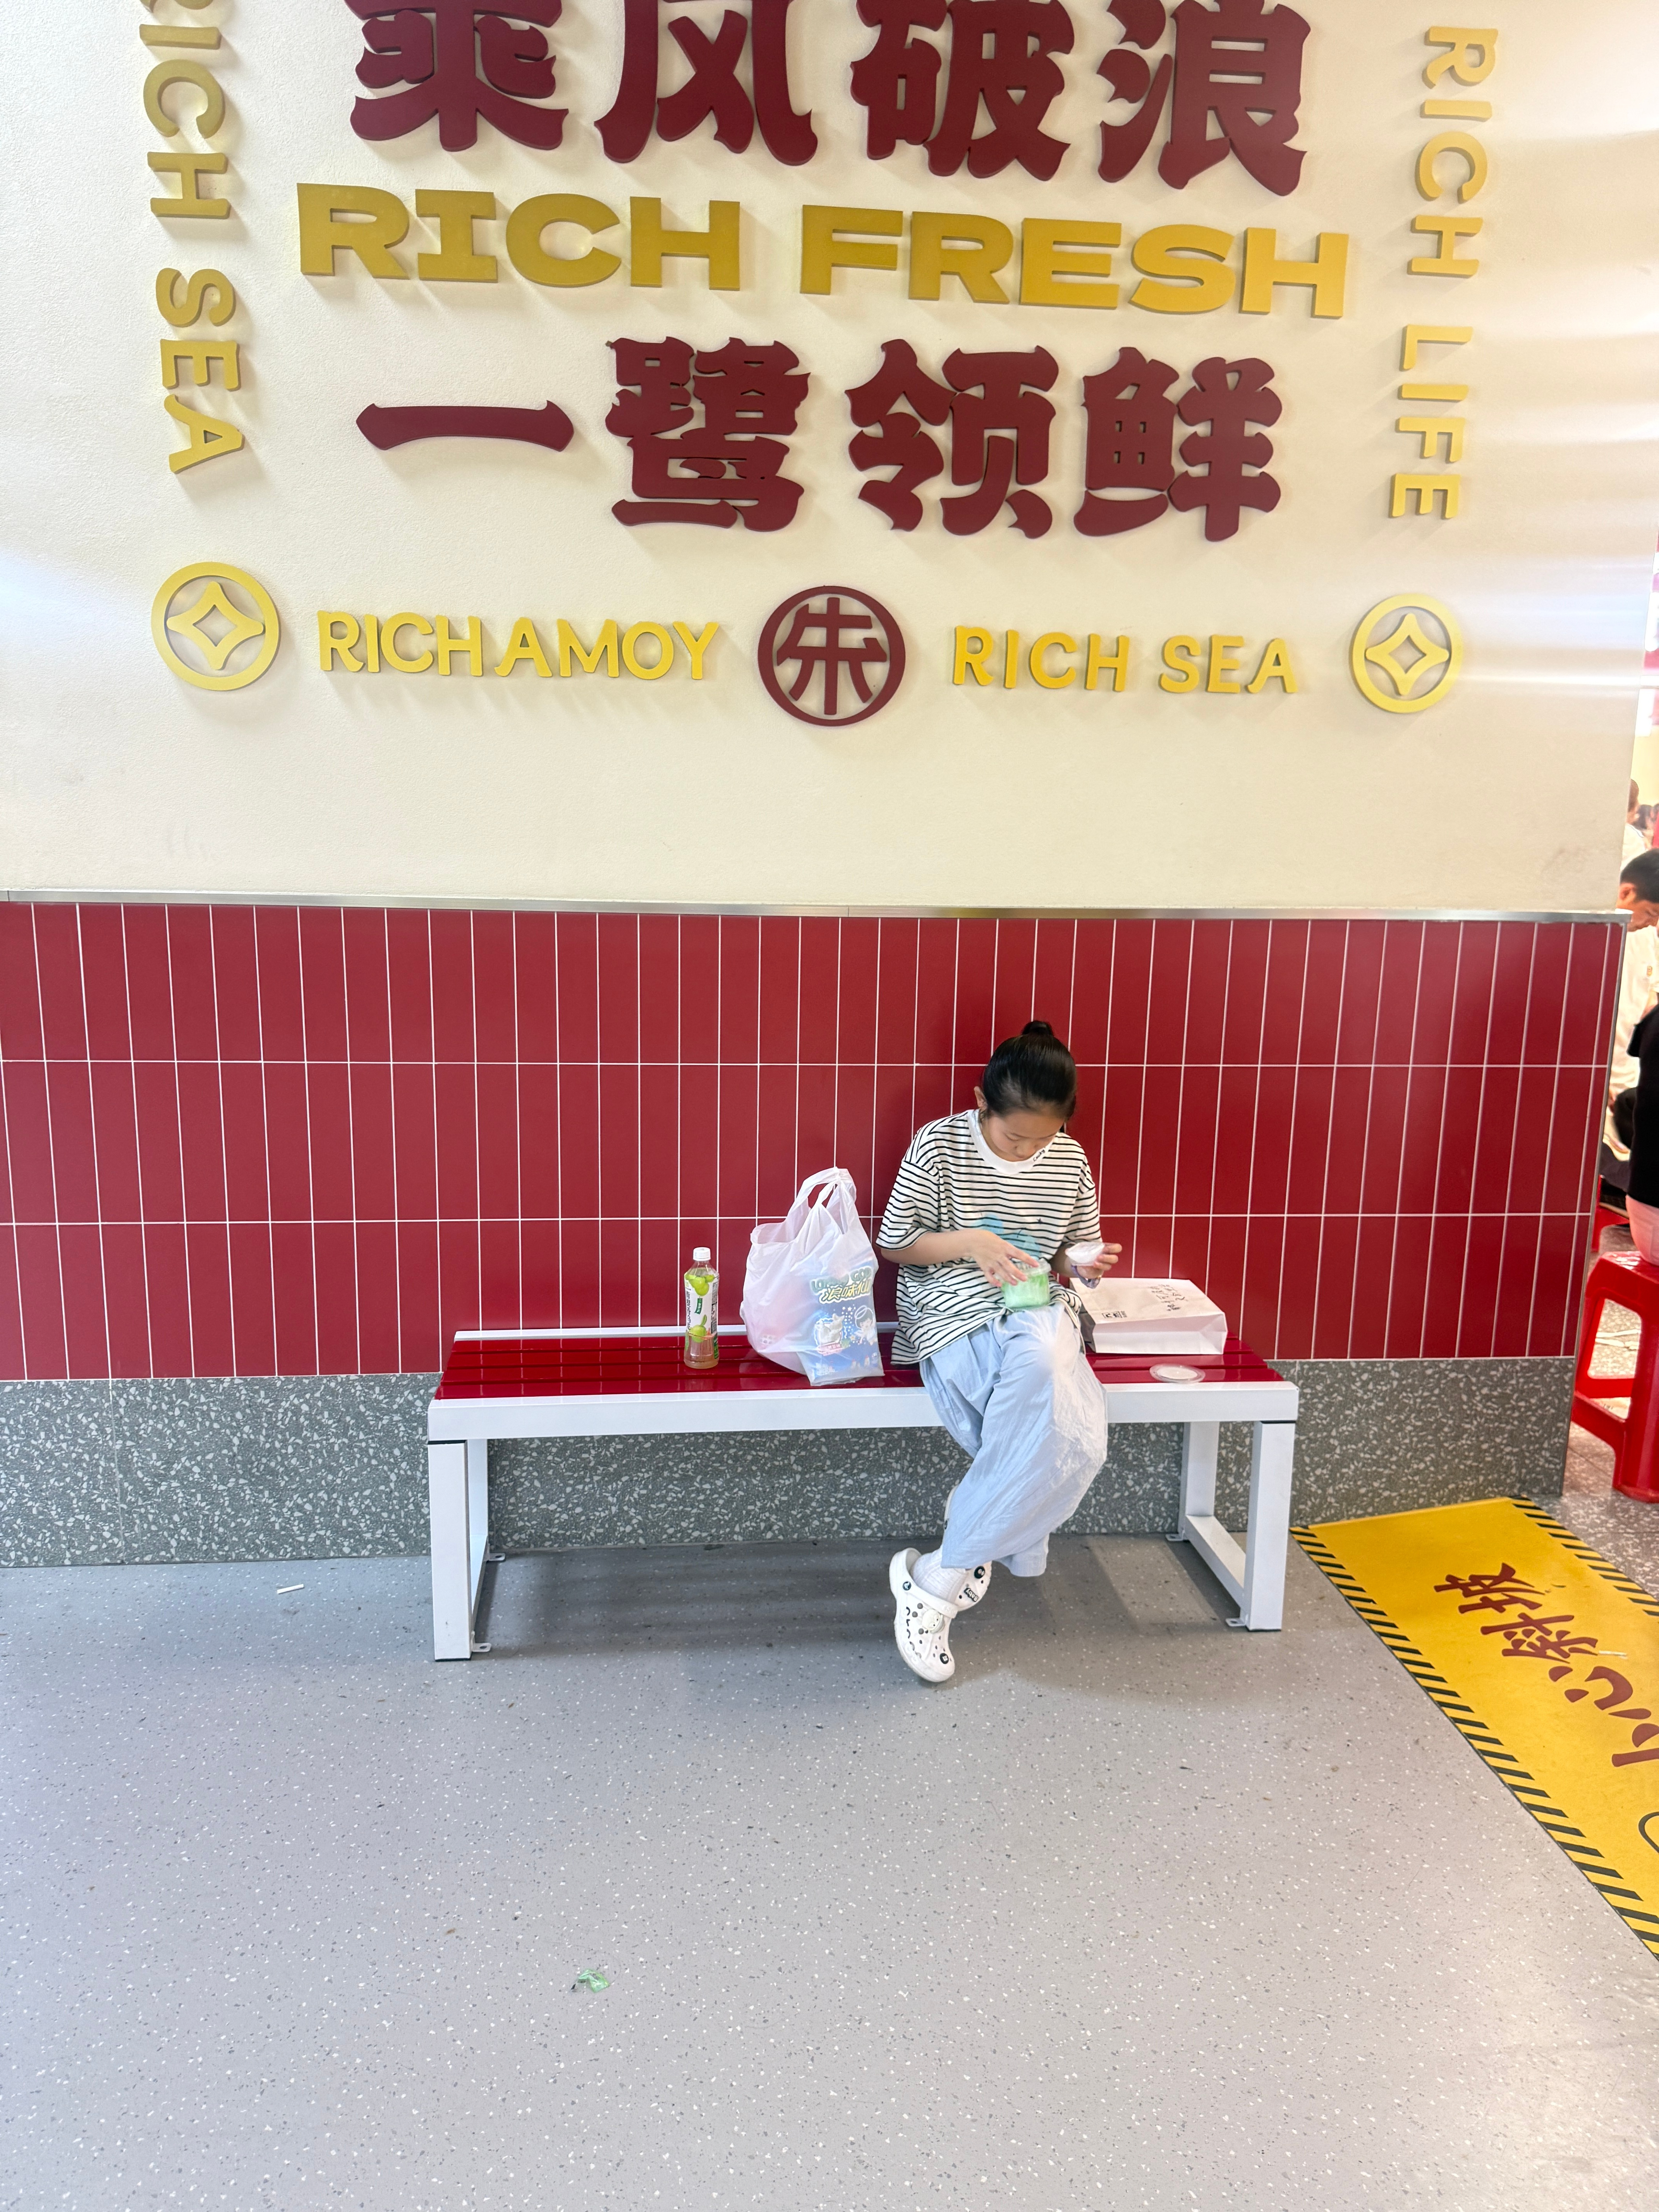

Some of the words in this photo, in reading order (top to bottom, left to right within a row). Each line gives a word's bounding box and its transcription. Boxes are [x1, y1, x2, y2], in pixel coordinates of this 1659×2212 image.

[139, 0, 231, 219] ICH
[350, 0, 1311, 195] 乘风破浪
[1407, 26, 1498, 278] RICH
[296, 182, 740, 291] RICH
[800, 204, 1350, 319] FRESH
[155, 267, 245, 474] SEA
[356, 336, 1283, 541] 一鹭领鲜
[1392, 324, 1473, 519] LIFE
[317, 610, 483, 677] RICH
[494, 617, 719, 680] AMOY
[776, 596, 888, 716] 朱
[952, 625, 1130, 693] RICH
[1160, 634, 1299, 694] SEA
[821, 1279, 872, 1302] 浪味仙
